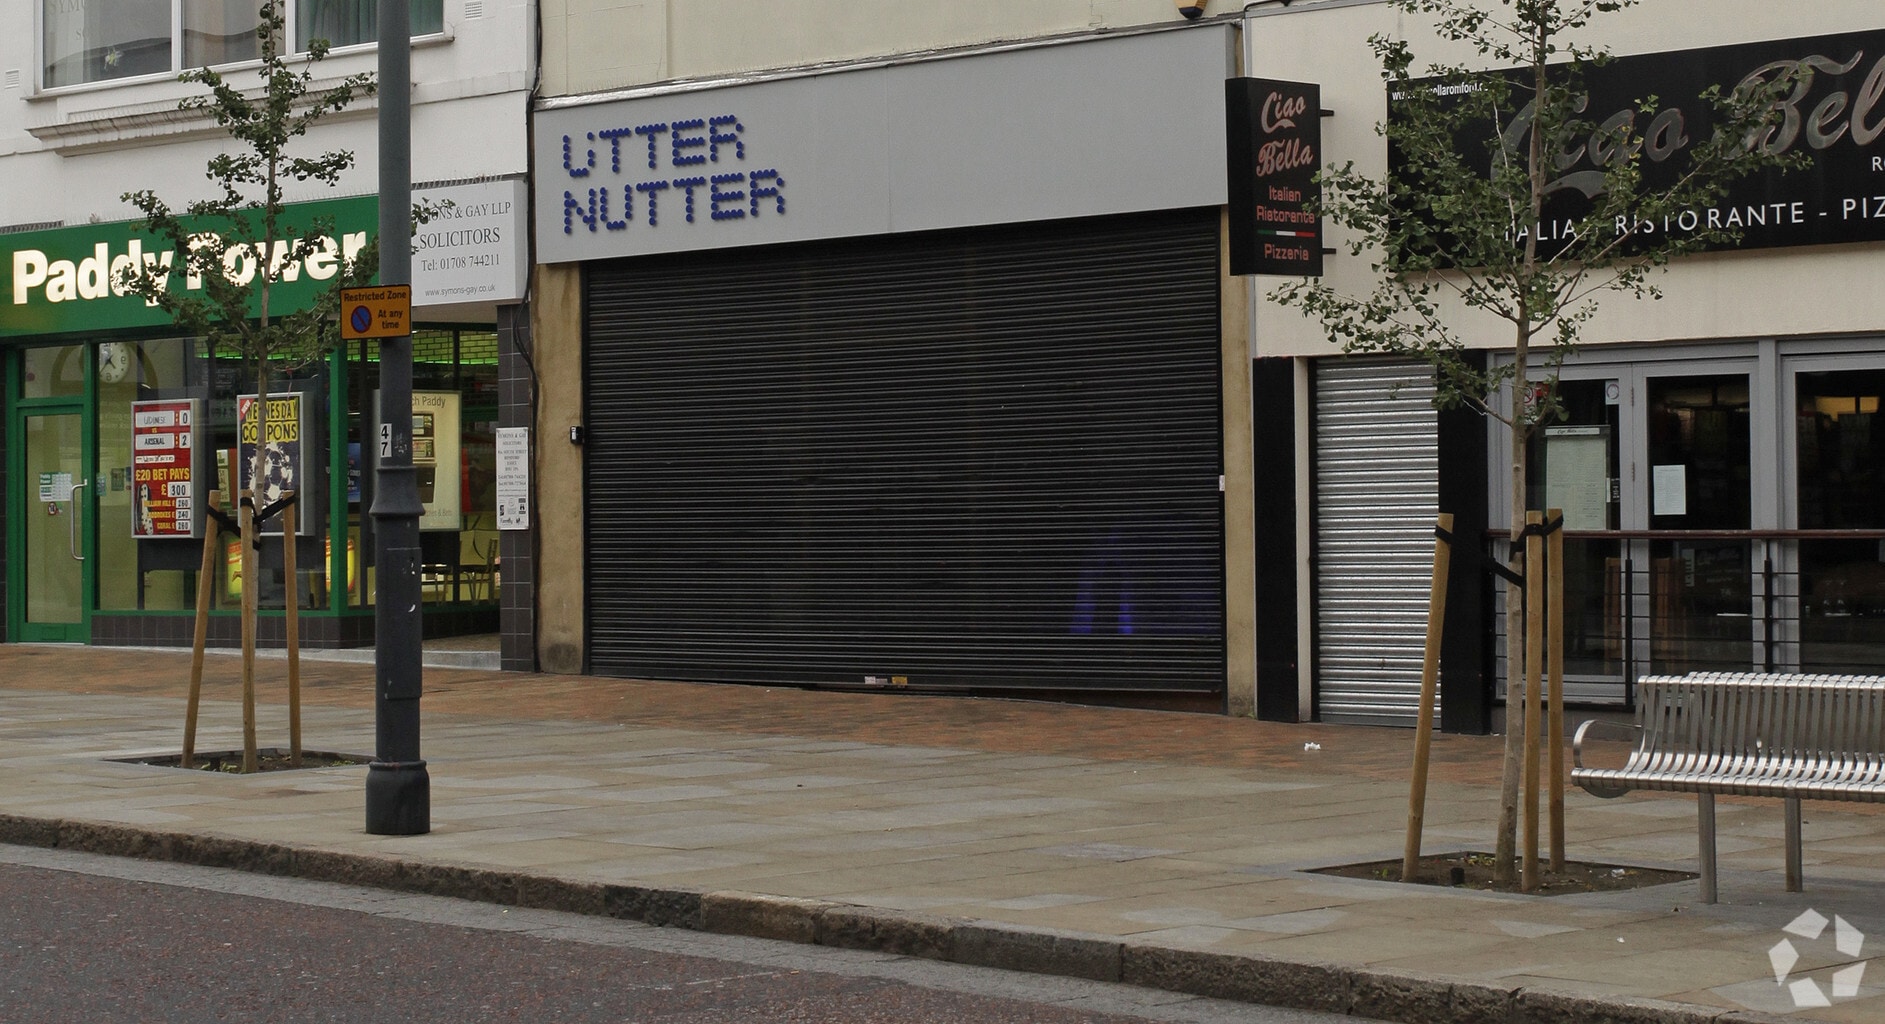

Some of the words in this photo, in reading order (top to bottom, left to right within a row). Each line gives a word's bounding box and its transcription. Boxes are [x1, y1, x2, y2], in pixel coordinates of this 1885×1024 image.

[1261, 91, 1306, 134] Ciao
[563, 114, 744, 178] UTTER
[1256, 137, 1314, 177] Bella
[1872, 156, 1885, 172] R
[563, 168, 785, 235] NUTTER
[1268, 185, 1301, 202] Italian
[455, 207, 463, 219] &
[465, 203, 489, 218] GAY
[491, 201, 511, 215] LLP
[1256, 205, 1315, 224] Ristorante
[420, 227, 500, 249] SOLICITORS
[1264, 243, 1310, 261] Pizzeria
[12, 239, 174, 307] Paddy
[187, 230, 366, 290] Power
[421, 259, 438, 271] Tel:
[440, 256, 466, 270] 01708
[469, 254, 499, 267] 744211
[344, 292, 385, 302] Restricted
[387, 291, 407, 300] Zone
[378, 310, 387, 318] At
[389, 310, 403, 319] any
[382, 321, 400, 329] time
[245, 402, 297, 420] WENESDAY
[422, 396, 446, 408] Paddy
[242, 423, 297, 441] COPONS
[135, 469, 151, 481] £20
[152, 468, 168, 480] BET
[169, 467, 190, 480] PAYS
[161, 483, 167, 495] £
[171, 484, 186, 496] 300
